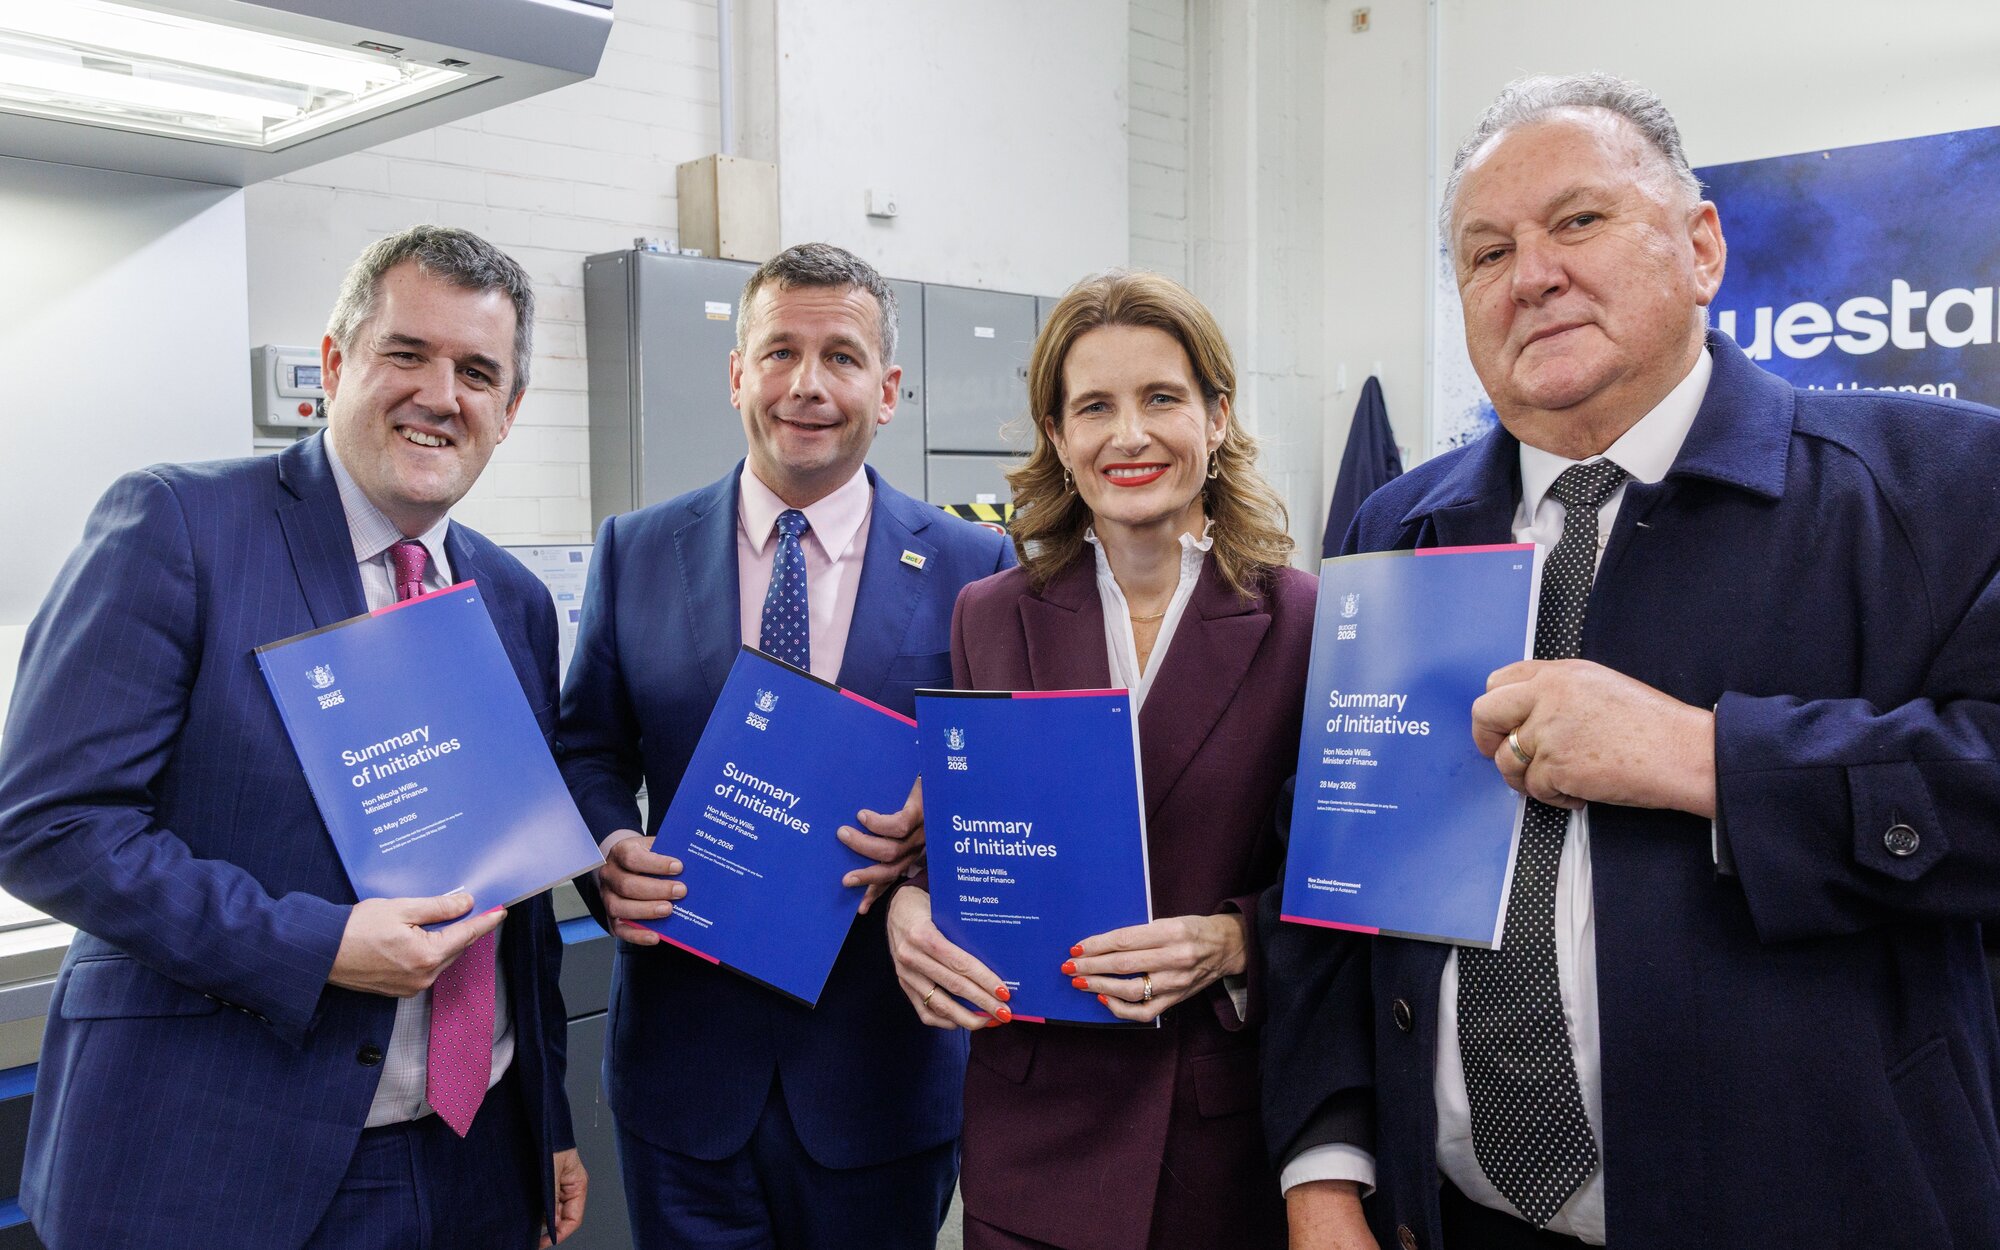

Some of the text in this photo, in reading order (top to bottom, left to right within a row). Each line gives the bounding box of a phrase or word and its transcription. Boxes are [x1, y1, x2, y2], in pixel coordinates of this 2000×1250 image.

[1718, 278, 2000, 360] uesta
[1338, 630, 1356, 640] 2026
[318, 690, 342, 701] BUDGET
[320, 695, 344, 709] 2026
[1329, 690, 1407, 712] Summary
[746, 717, 767, 730] 2026
[748, 712, 769, 723] BUDGET
[1326, 714, 1429, 735] of Initiatives
[342, 725, 428, 766] Summary
[352, 738, 460, 787] of Initiatives
[948, 762, 967, 770] 2026
[1352, 758, 1377, 766] Finance
[361, 782, 417, 807] Hon Nicola Willis
[723, 762, 800, 808] Summary
[1327, 781, 1339, 790] May
[1339, 781, 1356, 789] 2026
[364, 800, 392, 814] Minister
[400, 787, 428, 800] Finance
[714, 784, 810, 833] of Initiatives
[373, 812, 417, 834] 28 May 2026
[703, 812, 728, 826] Minister
[735, 826, 758, 840] Finance
[706, 805, 754, 830] Hon Nicola Willis
[952, 815, 1032, 837] Summary
[704, 833, 717, 844] May
[717, 839, 733, 850] 2026
[954, 837, 1057, 857] of Initiatives
[1333, 880, 1361, 888] Government
[968, 896, 981, 904] May
